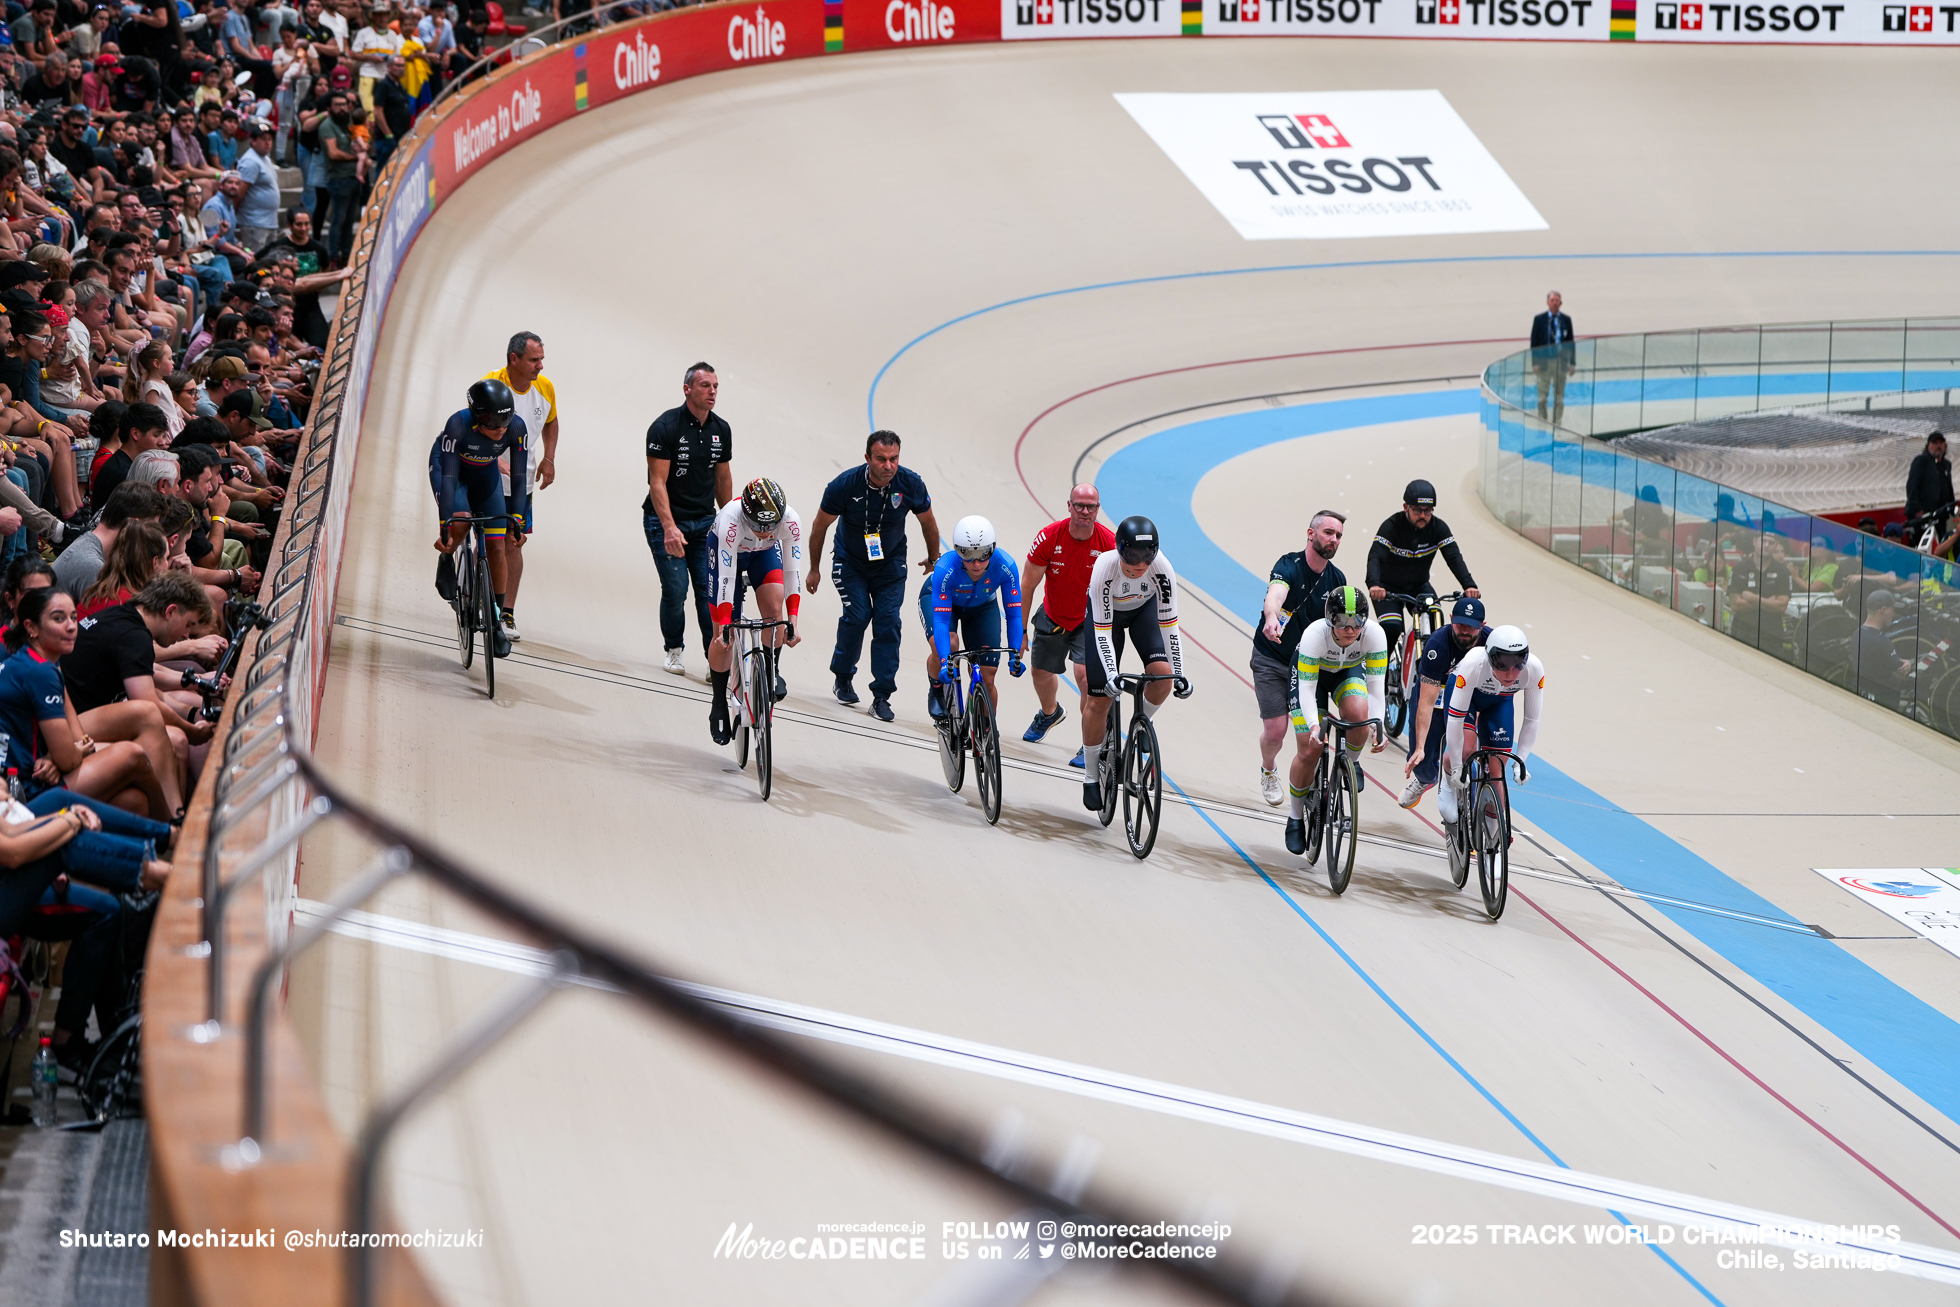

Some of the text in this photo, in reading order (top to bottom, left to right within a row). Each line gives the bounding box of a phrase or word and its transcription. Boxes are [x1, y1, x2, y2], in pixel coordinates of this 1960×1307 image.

[884, 0, 956, 42] Chile
[1062, 0, 1164, 23] TISSOT
[1270, 0, 1382, 24] TISSOT
[1466, 0, 1592, 27] TISSOT
[1709, 4, 1845, 32] TISSOT
[727, 5, 786, 61] Chile
[613, 30, 660, 90] Chile
[453, 77, 541, 174] Welcome to Chile
[1232, 156, 1442, 196] TISSOT
[1394, 548, 1408, 556] UCI
[1155, 573, 1172, 604] KTM
[1097, 636, 1117, 673] BIORACER
[1169, 634, 1182, 676] BIORACER
